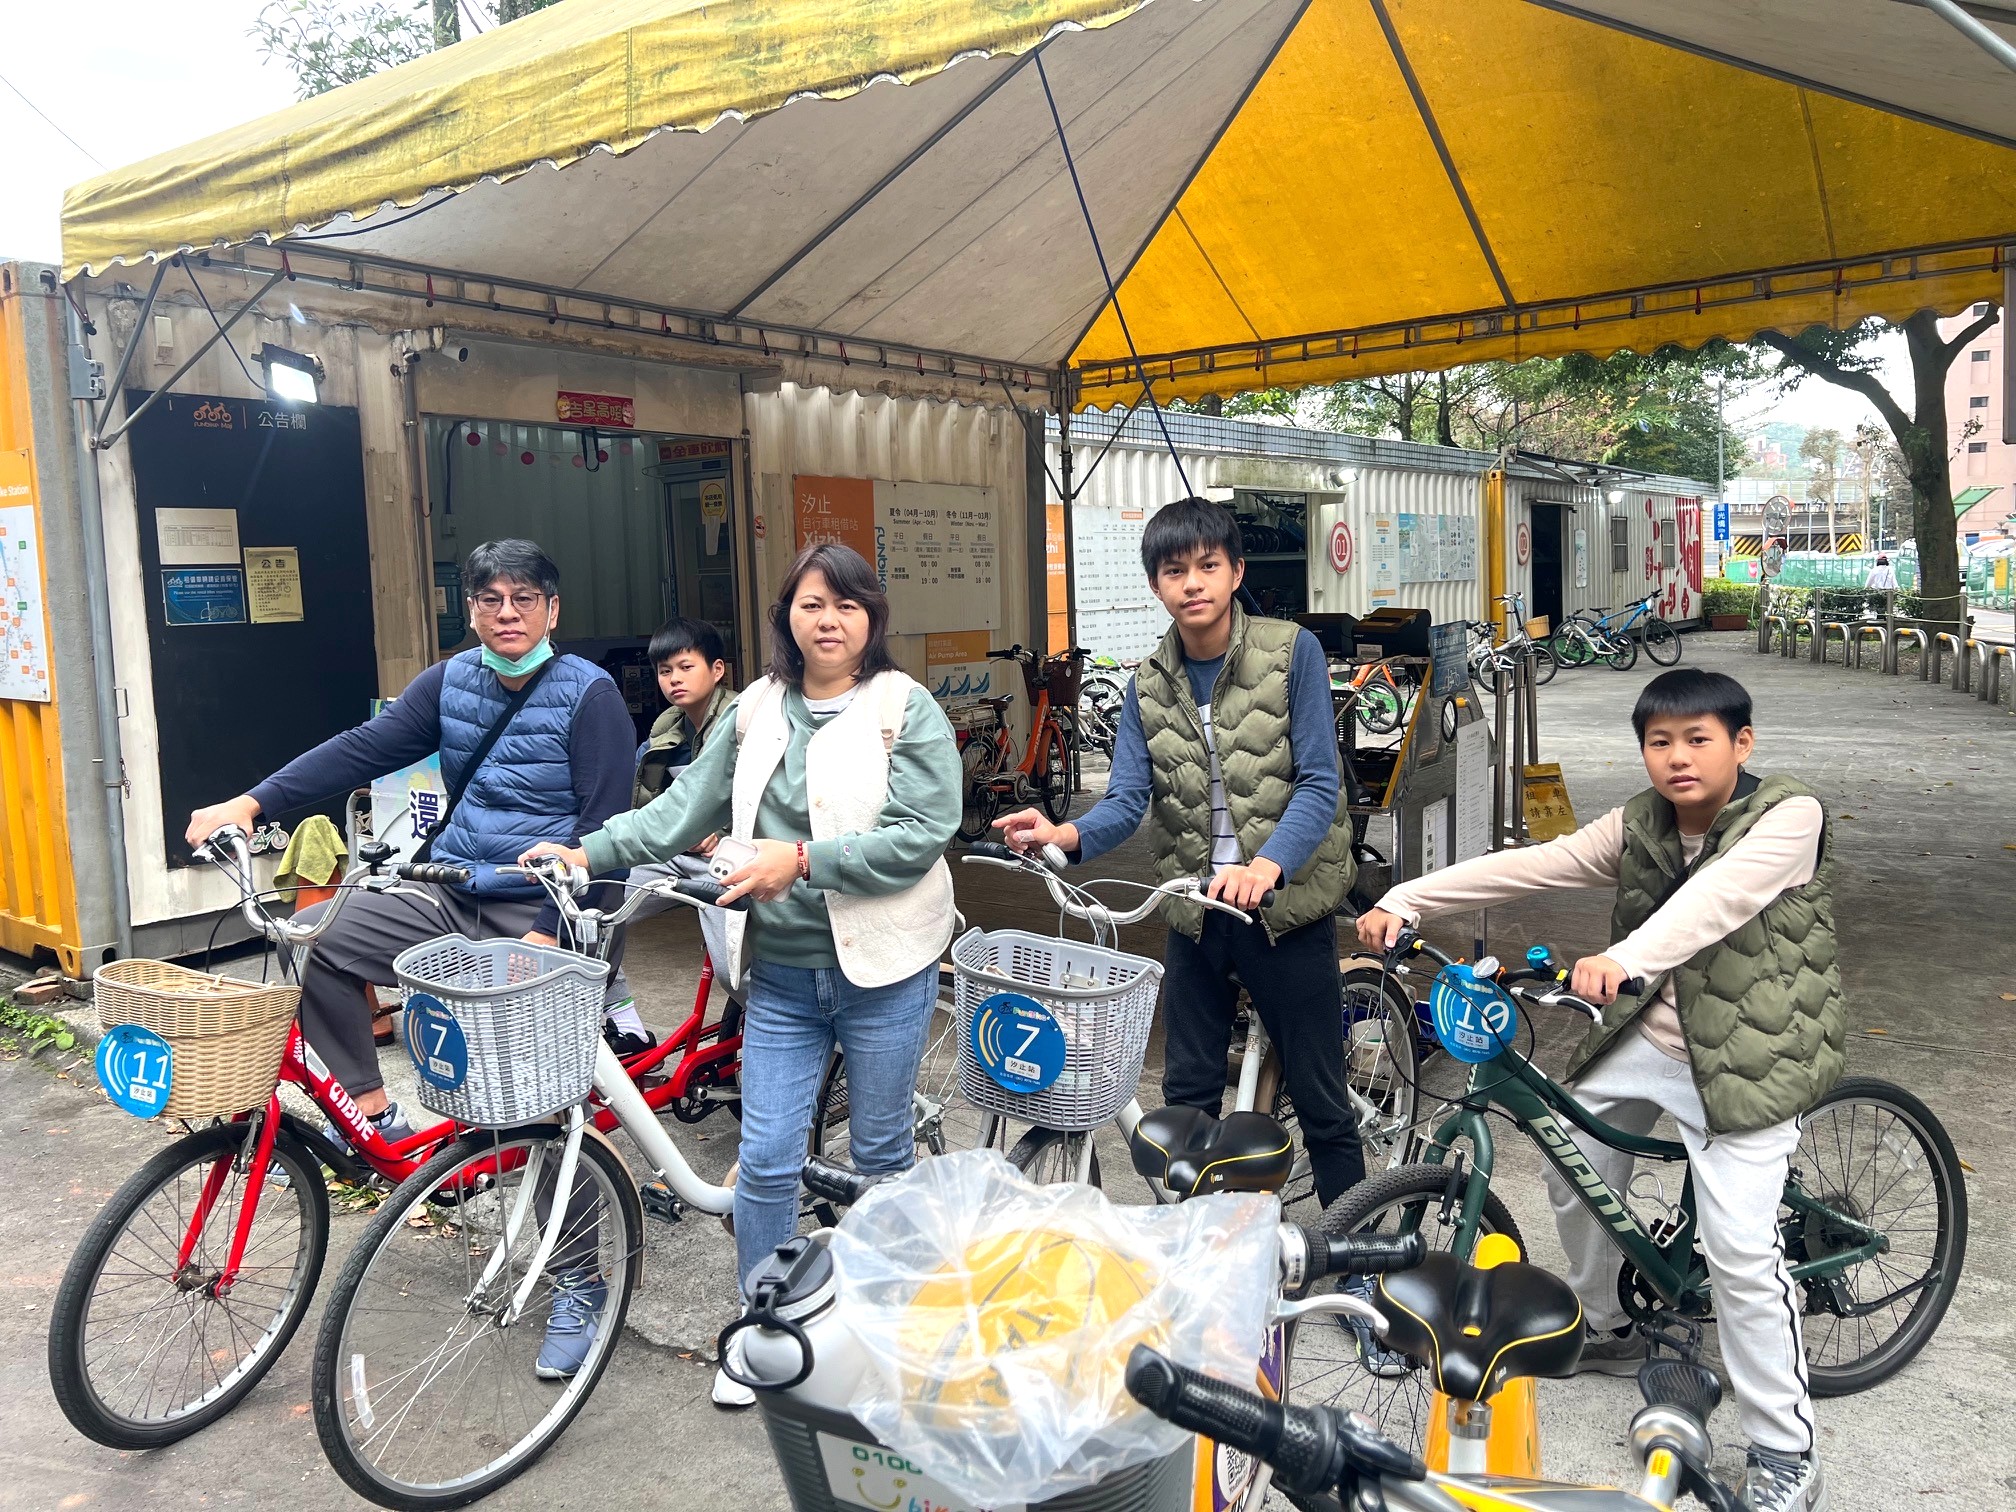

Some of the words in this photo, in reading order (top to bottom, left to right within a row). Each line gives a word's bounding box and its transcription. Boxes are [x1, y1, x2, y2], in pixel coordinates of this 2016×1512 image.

[258, 411, 307, 430] 公告欄
[570, 400, 623, 422] 吉星高照
[8, 485, 28, 496] Station
[801, 493, 832, 514] 汐止
[803, 517, 859, 531] 自行車租借站
[1335, 538, 1347, 556] 01
[261, 558, 286, 569] 公告
[938, 651, 954, 659] Pump
[1456, 997, 1510, 1034] 10
[430, 1023, 447, 1056] 7
[1013, 1023, 1040, 1057] 7
[130, 1051, 169, 1090] 11
[1010, 1060, 1035, 1073] 汐止站
[1528, 1115, 1647, 1238] GIANT
